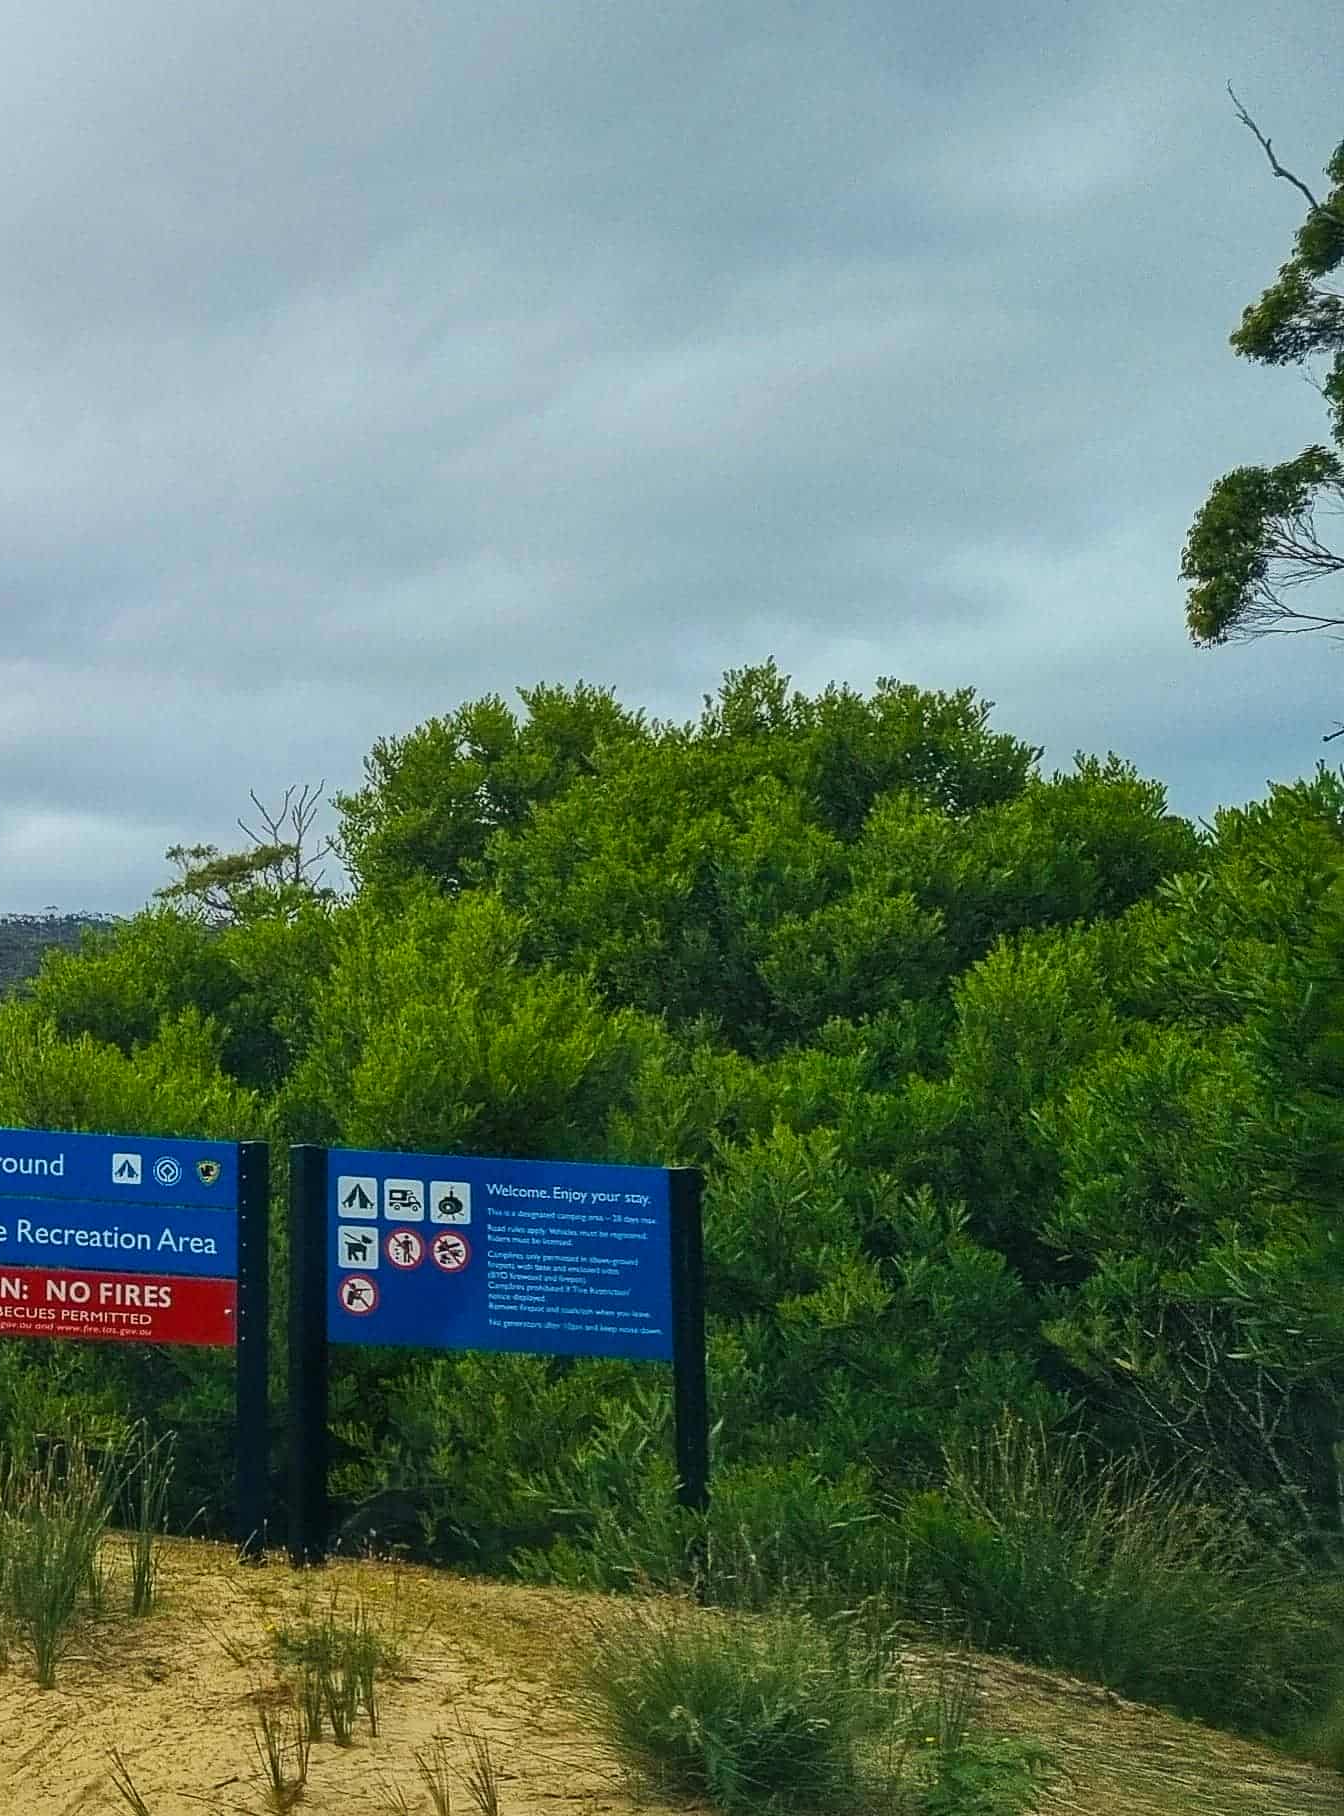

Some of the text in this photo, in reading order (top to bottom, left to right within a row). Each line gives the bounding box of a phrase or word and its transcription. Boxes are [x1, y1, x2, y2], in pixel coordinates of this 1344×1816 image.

[486, 1183, 551, 1199] Welcome.
[553, 1187, 587, 1204] Enjoy
[591, 1192, 621, 1204] your
[17, 1219, 151, 1251] Recreation
[157, 1229, 217, 1254] Area
[46, 1279, 90, 1303] NO
[98, 1283, 173, 1308] FIRES
[35, 1322, 54, 1331] and
[61, 1309, 153, 1326] PERMITTED
